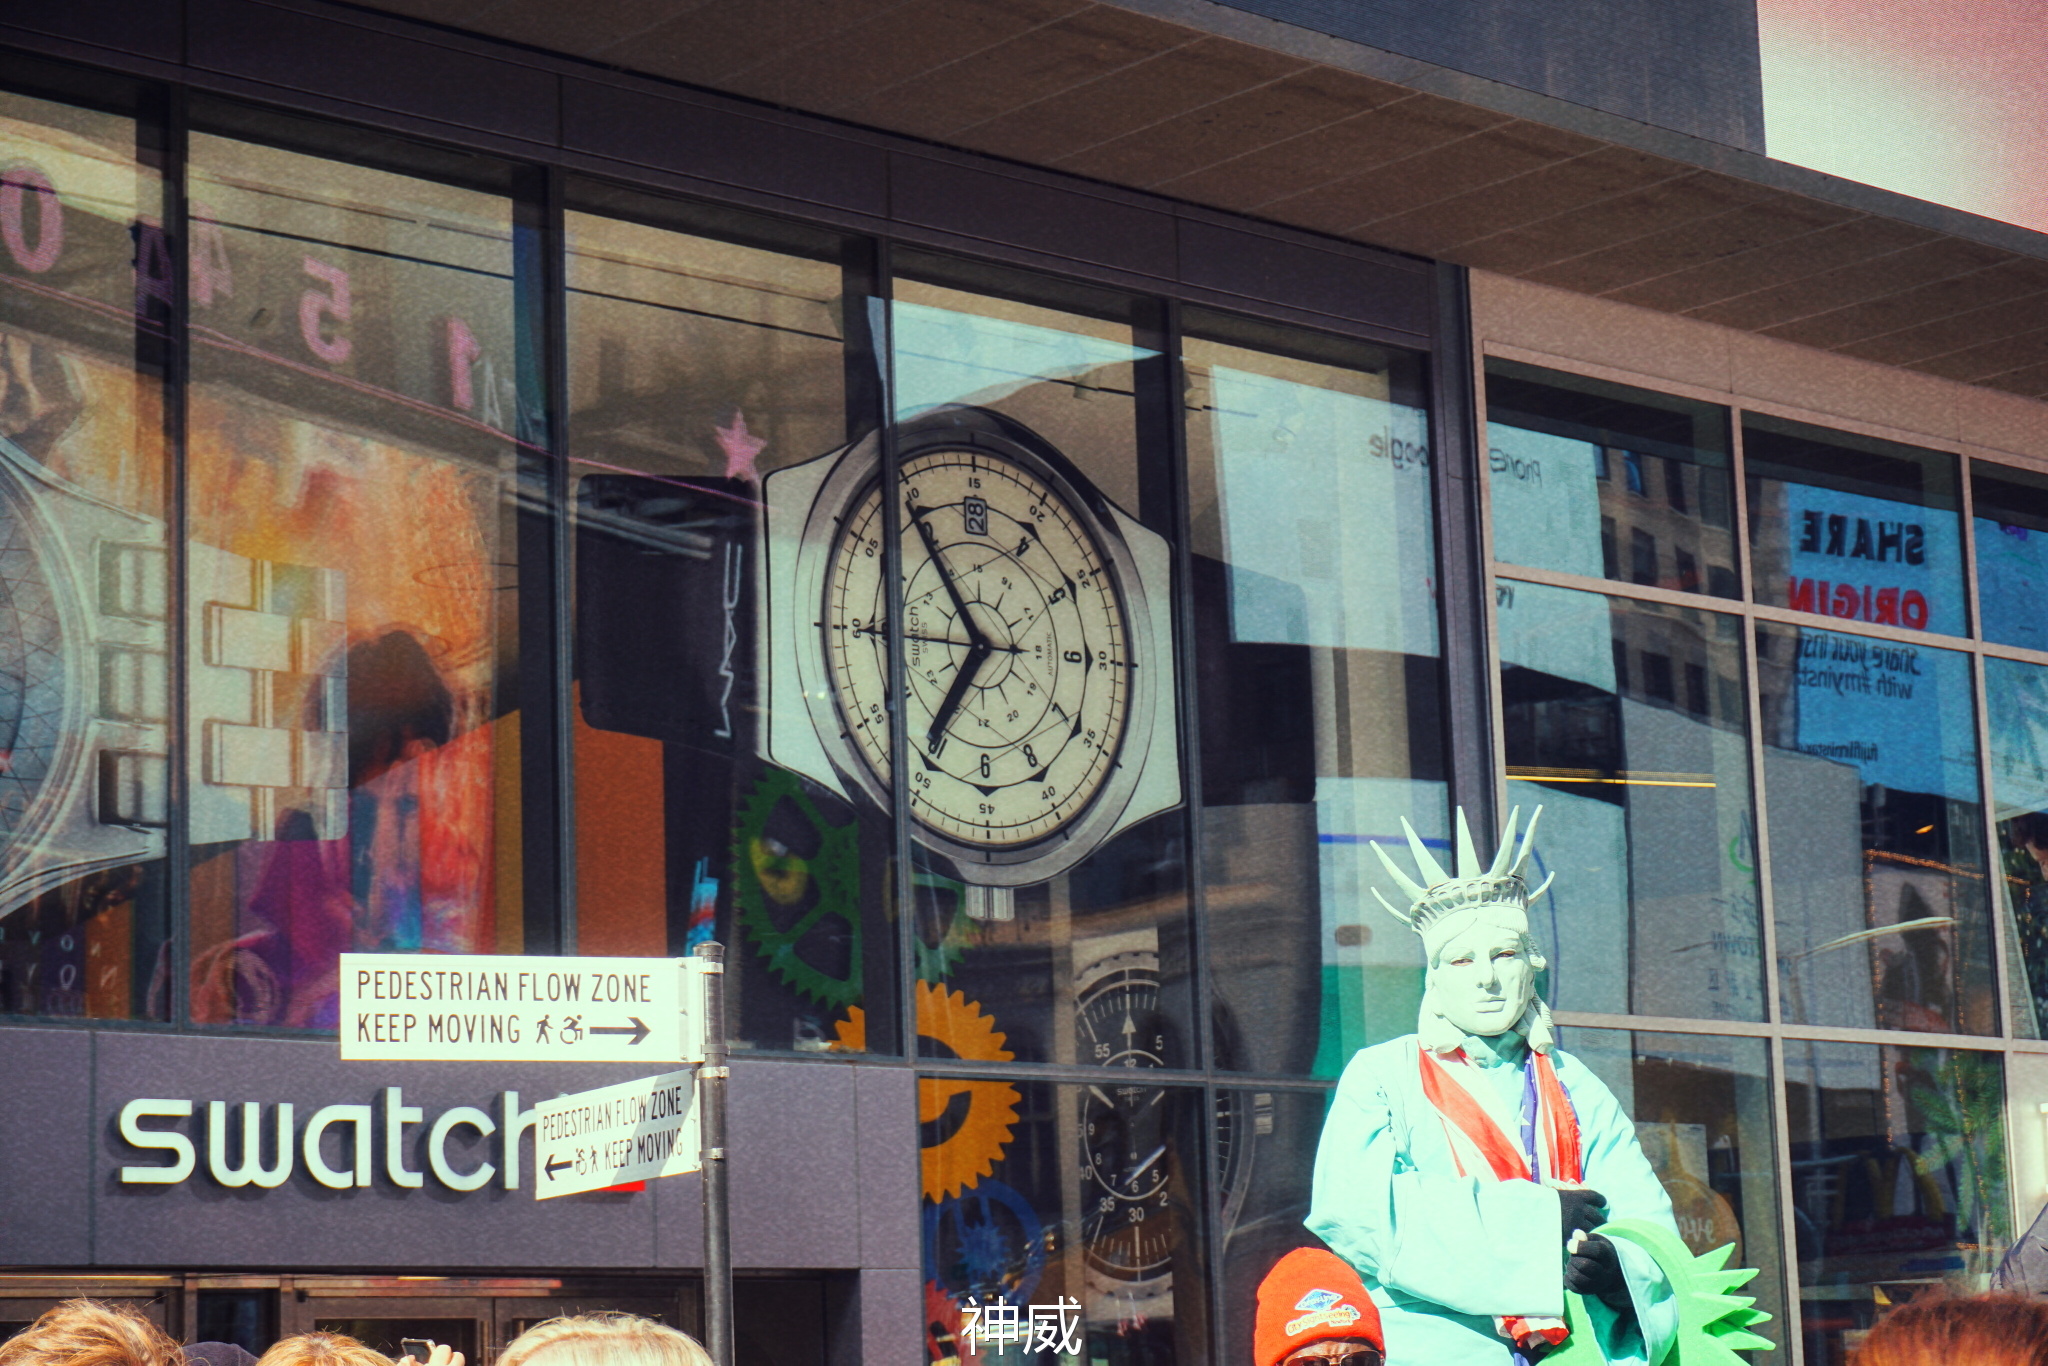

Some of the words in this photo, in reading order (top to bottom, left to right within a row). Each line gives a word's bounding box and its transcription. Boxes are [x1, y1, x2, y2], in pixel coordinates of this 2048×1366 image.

[968, 477, 981, 488] 15
[907, 487, 919, 501] 10
[968, 503, 984, 532] 28
[1029, 505, 1046, 522] 20
[865, 537, 879, 558] 05
[1016, 536, 1030, 557] 4
[1077, 569, 1091, 589] 25
[1047, 587, 1066, 605] 5
[852, 618, 861, 639] 60
[909, 606, 921, 667] swatch
[921, 622, 929, 654] SWISS
[1035, 645, 1042, 660] 18
[1098, 650, 1107, 671] 30
[869, 703, 884, 724] 55
[1006, 709, 1019, 722] 20
[1051, 701, 1070, 722] 7
[1083, 728, 1096, 748] 35
[1023, 743, 1038, 768] 8
[915, 771, 931, 789] 50
[1041, 785, 1056, 800] 40
[978, 803, 995, 815] 45
[357, 970, 508, 1001] PEDESTRIAN
[519, 972, 582, 1002] FLOW
[591, 973, 652, 1003] ZONE
[357, 1013, 417, 1043] KEEP
[428, 1014, 520, 1044] MOVING
[1095, 1042, 1110, 1059] 55
[543, 1102, 612, 1142] PEDESTRIAN
[616, 1094, 647, 1127] FLOW
[651, 1085, 682, 1121] ZONE
[1088, 1122, 1095, 1136] 9
[605, 1138, 633, 1170] KEEP
[637, 1127, 683, 1164] MOVING
[1095, 1152, 1102, 1165] 8
[1110, 1174, 1117, 1186] 7
[1152, 1169, 1159, 1183] 5
[1131, 1180, 1139, 1193] 6
[1099, 1196, 1115, 1212] 35
[1159, 1191, 1168, 1206] 2
[1128, 1206, 1145, 1223] 30
